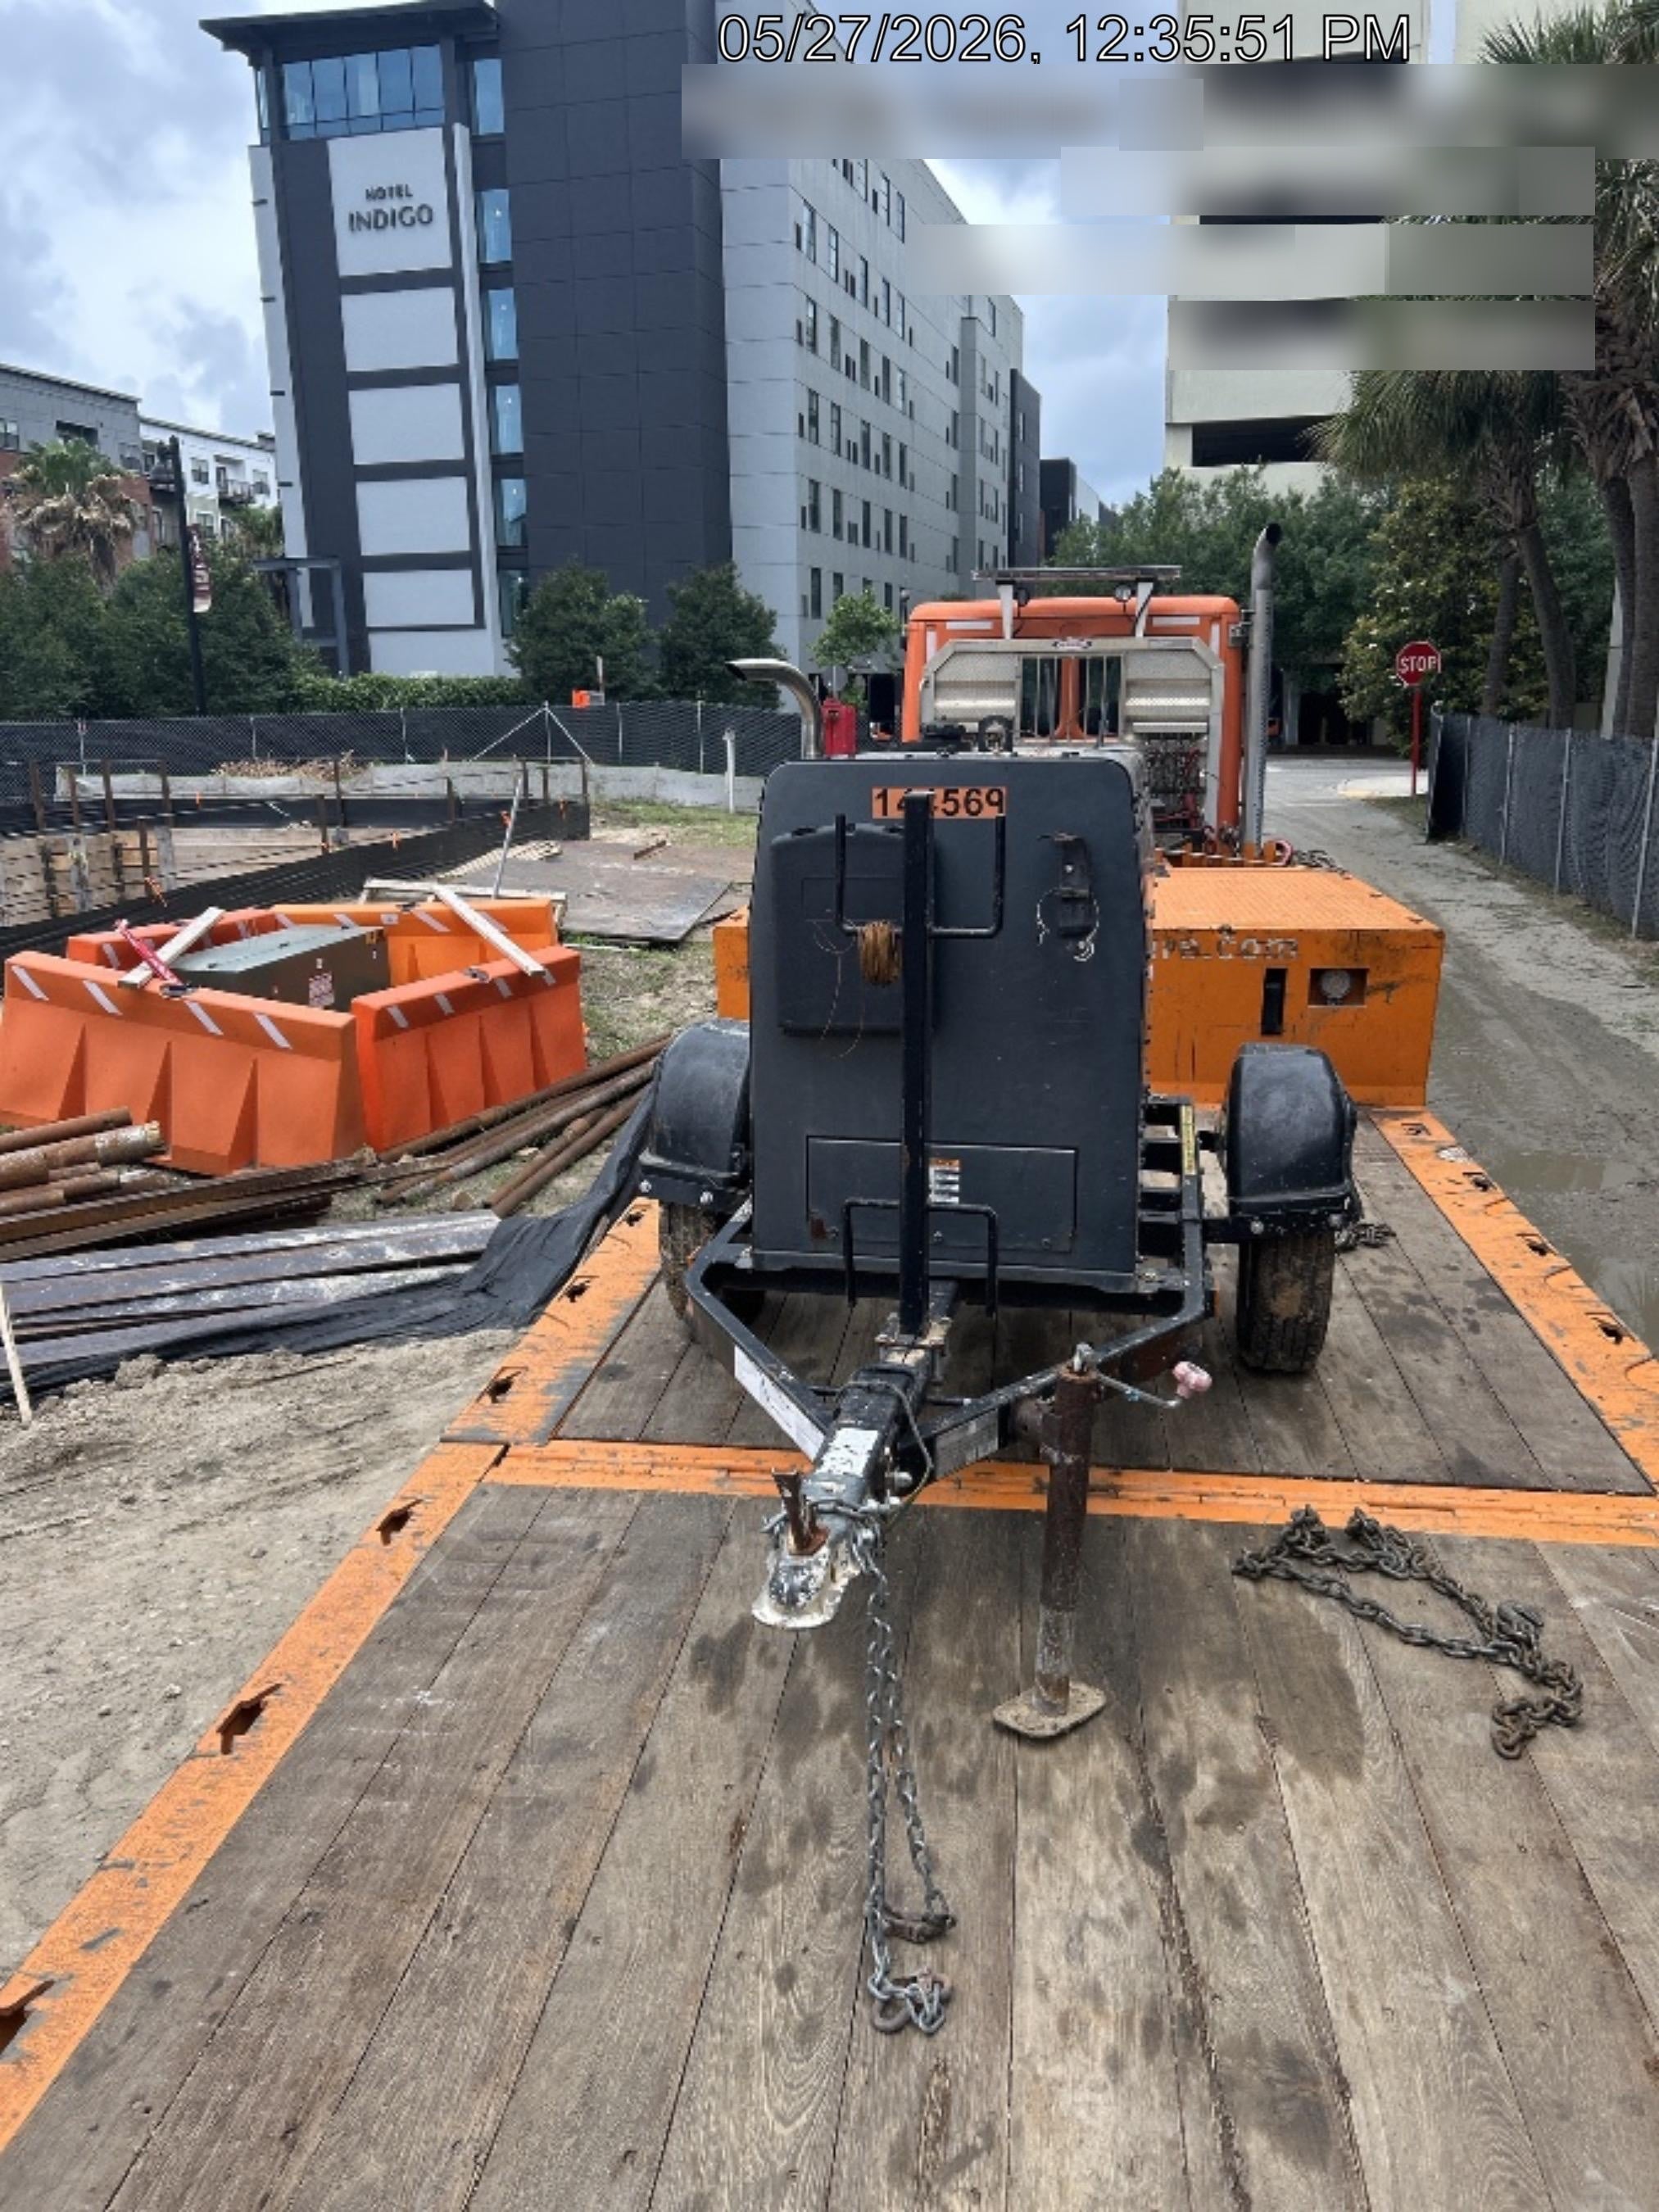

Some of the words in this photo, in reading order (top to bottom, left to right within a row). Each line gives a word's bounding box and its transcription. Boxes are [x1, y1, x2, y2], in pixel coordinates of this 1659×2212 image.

[365, 184, 413, 202] HOTEL
[349, 203, 433, 232] INDIGO
[1400, 655, 1436, 673] STOP
